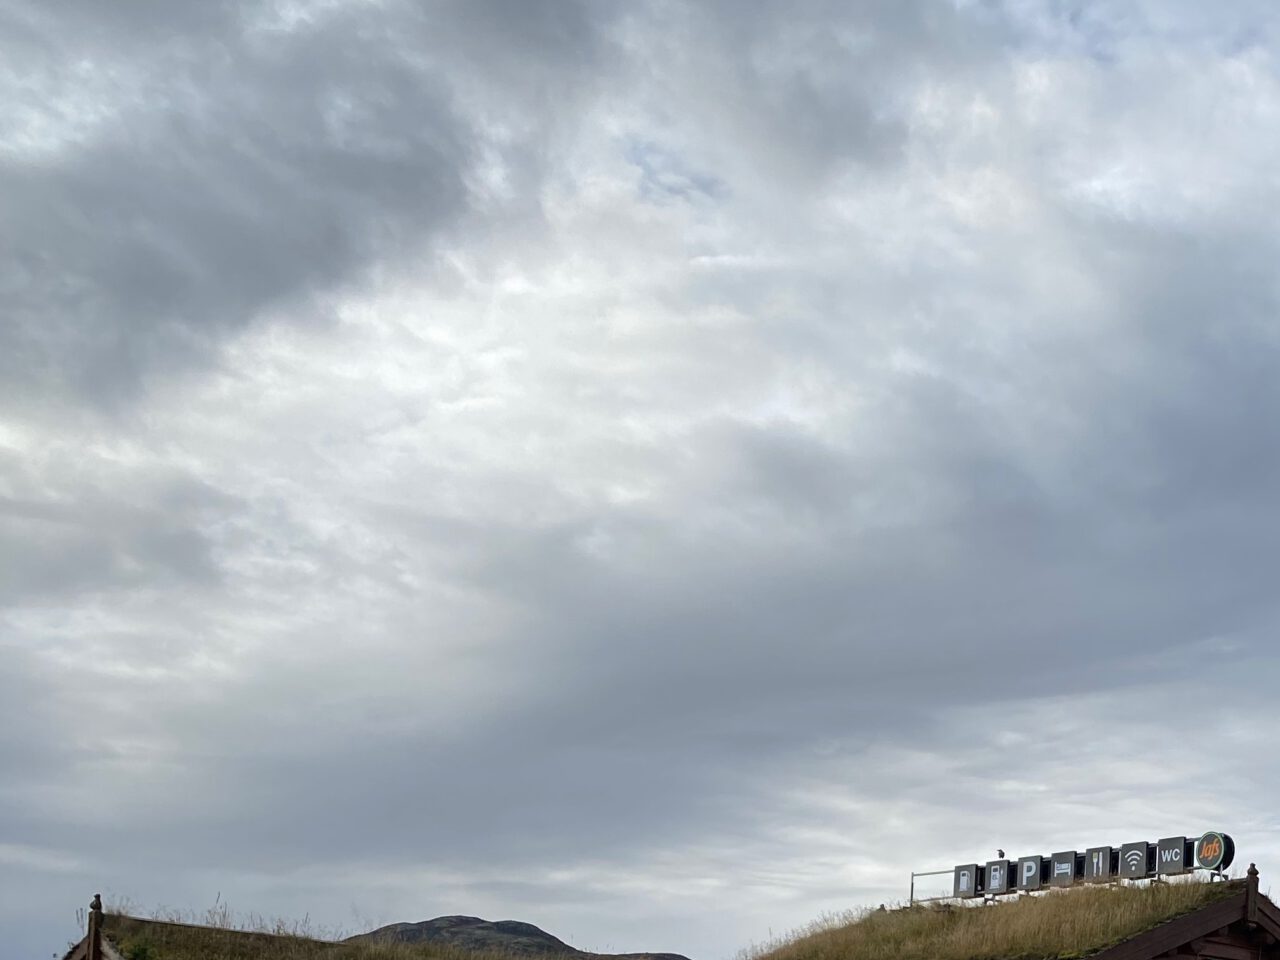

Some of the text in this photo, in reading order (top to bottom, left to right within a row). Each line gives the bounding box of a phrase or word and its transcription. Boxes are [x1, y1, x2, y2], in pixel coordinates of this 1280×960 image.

[1161, 848, 1181, 862] WC
[1199, 838, 1220, 860] Jafs
[1022, 861, 1037, 886] P
